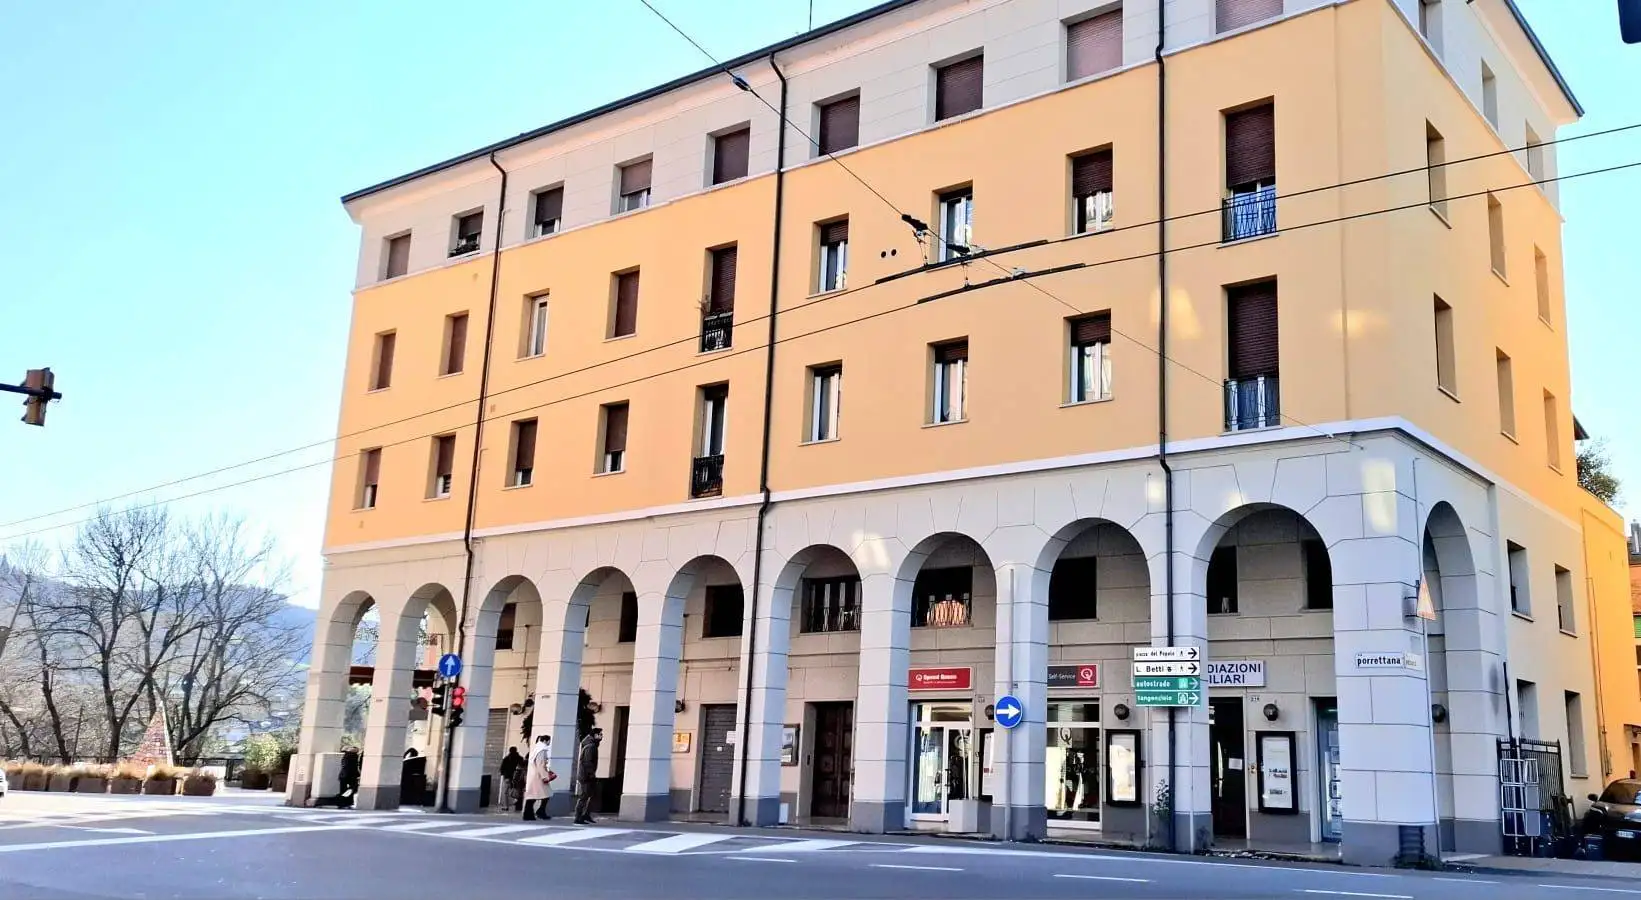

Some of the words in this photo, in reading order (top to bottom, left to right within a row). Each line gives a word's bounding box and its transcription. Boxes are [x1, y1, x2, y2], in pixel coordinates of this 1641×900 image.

[1357, 656, 1401, 668] porrettana
[1207, 663, 1261, 673] DIAZIONI
[1209, 674, 1245, 684] ILIARI
